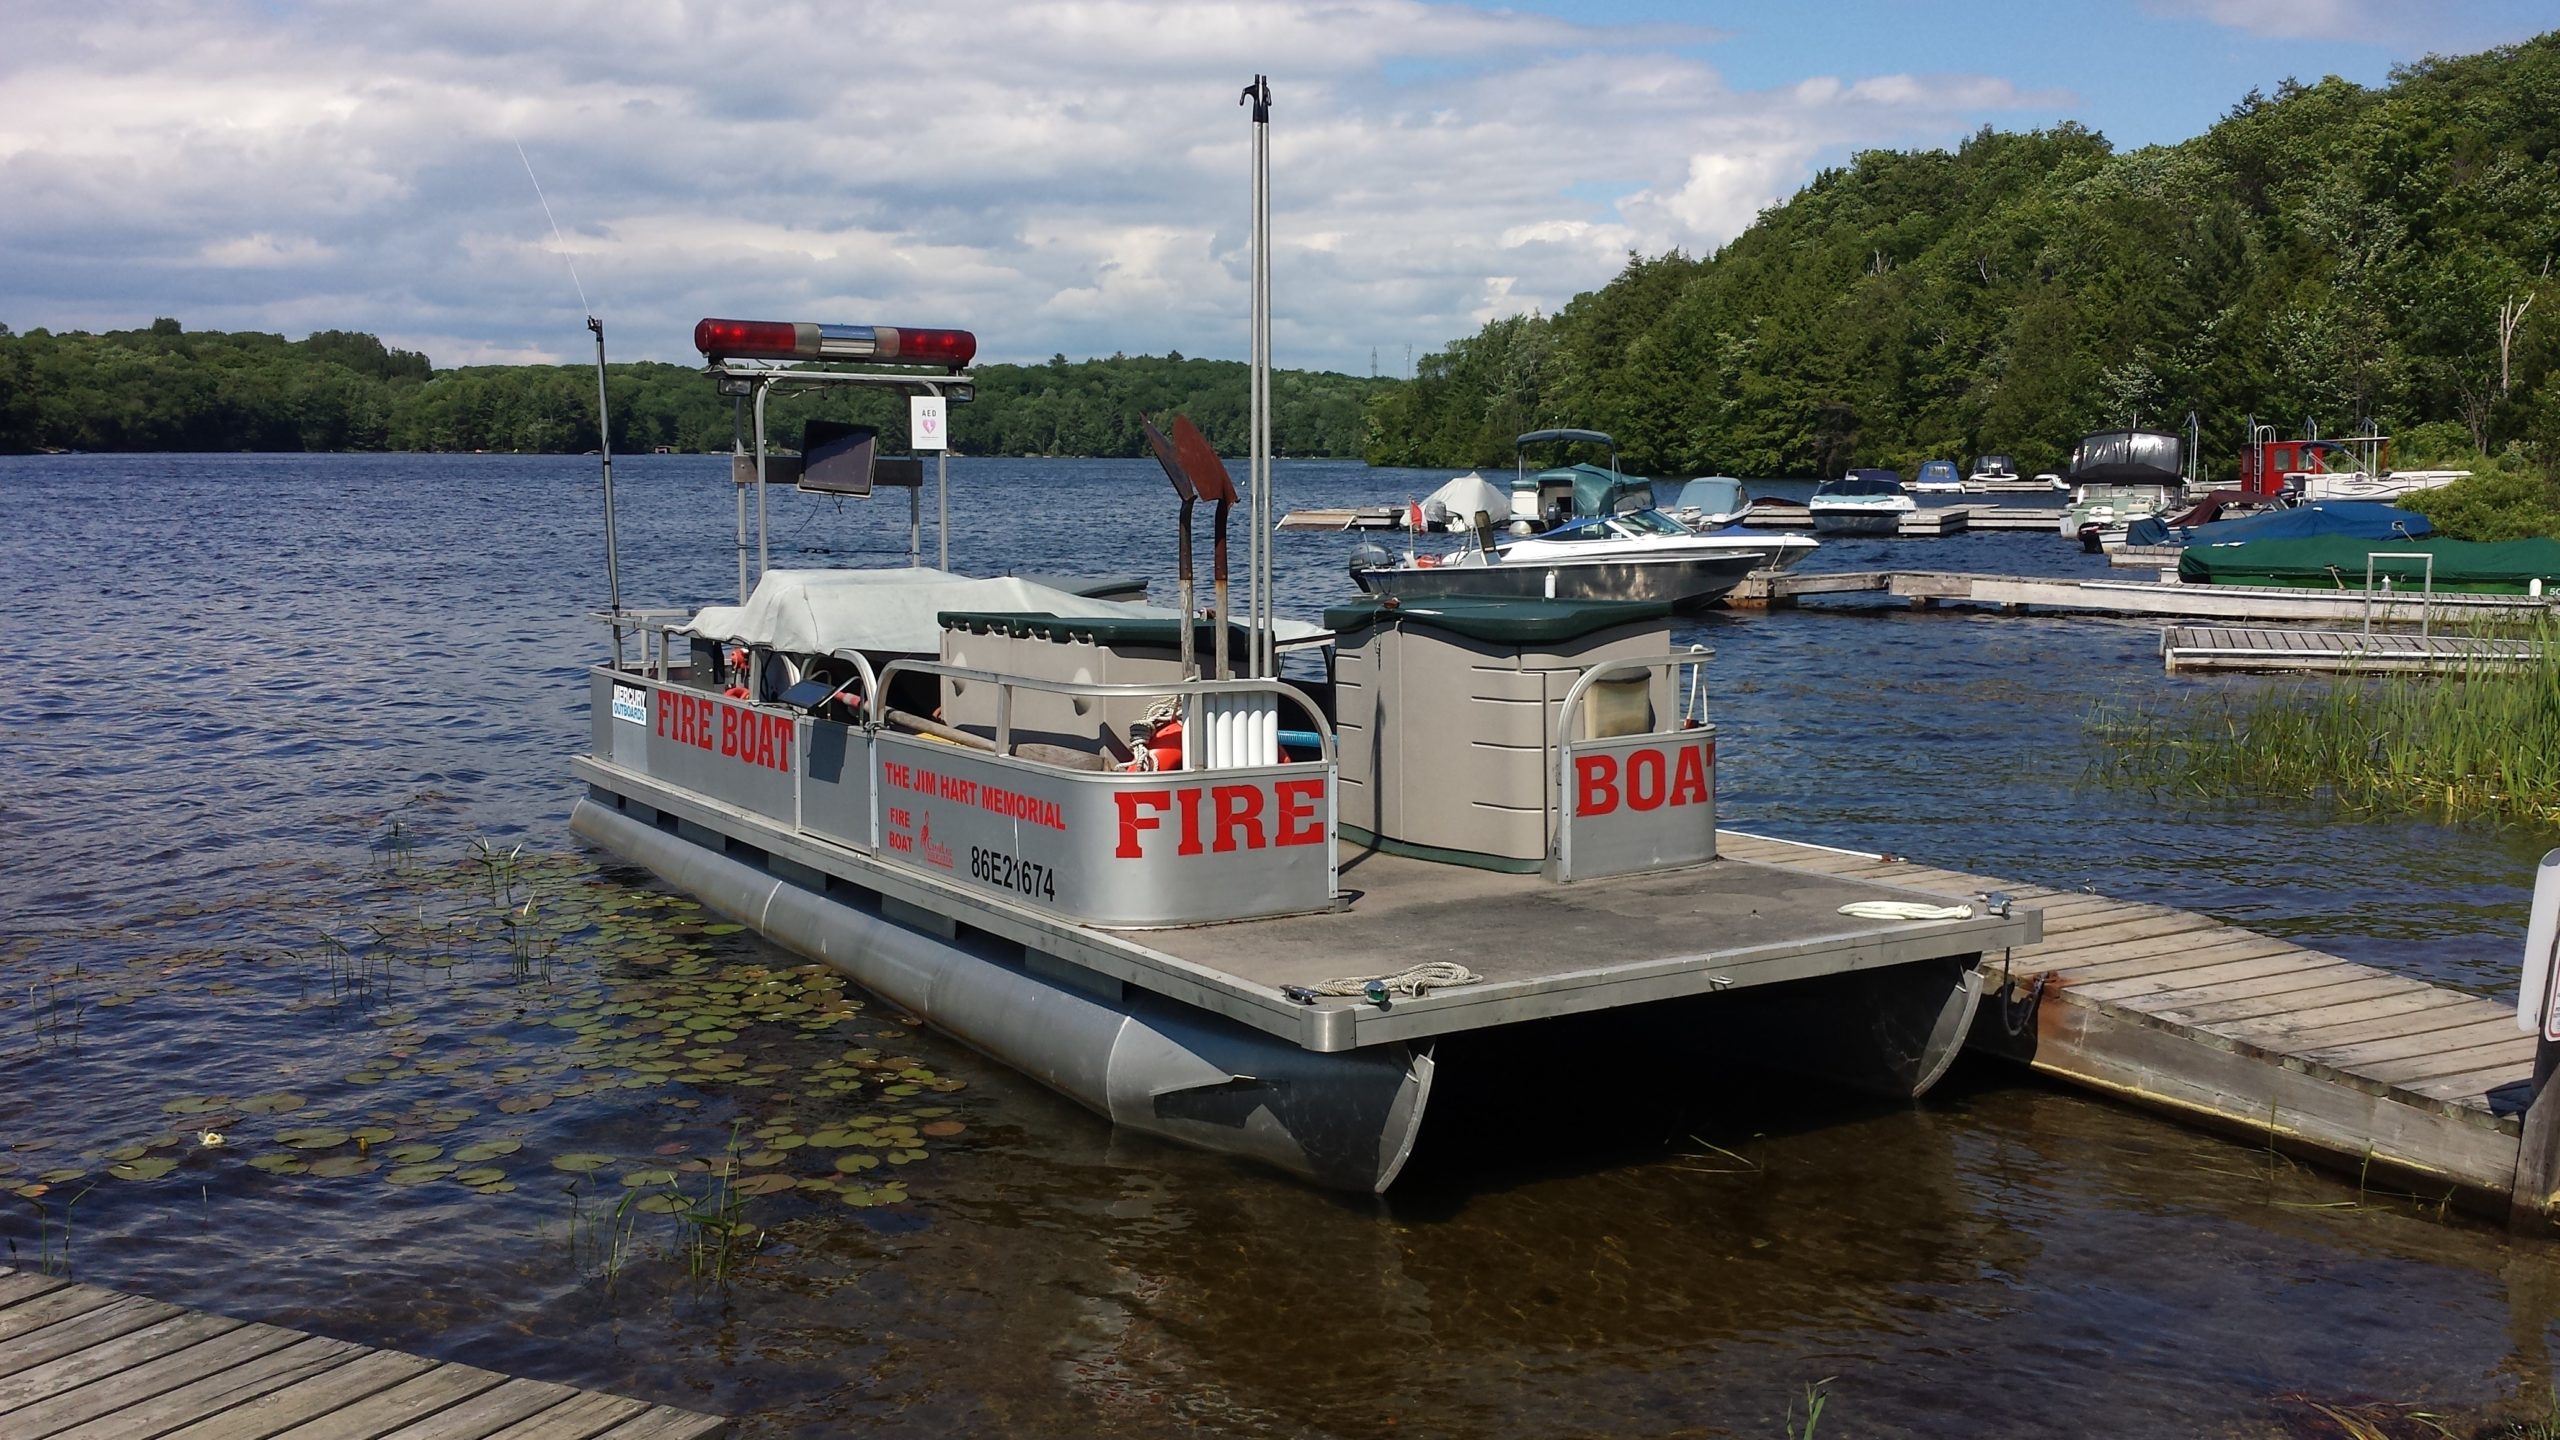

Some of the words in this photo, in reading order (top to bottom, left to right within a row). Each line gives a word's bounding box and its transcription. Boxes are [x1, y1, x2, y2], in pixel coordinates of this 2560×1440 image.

[921, 409, 937, 417] AED
[613, 684, 647, 708] MERCURY
[614, 701, 645, 721] OUTBOARDS
[657, 689, 714, 751] FIRE
[721, 703, 794, 772] BOAT
[884, 762, 910, 789] THE
[913, 769, 936, 796] JIM
[940, 775, 978, 804] HART
[982, 785, 1066, 831] MEMORIAL
[889, 808, 911, 828] FIRE
[1114, 779, 1325, 859] FIRE
[889, 831, 913, 853] BOAT
[971, 845, 1055, 902] 86E21674
